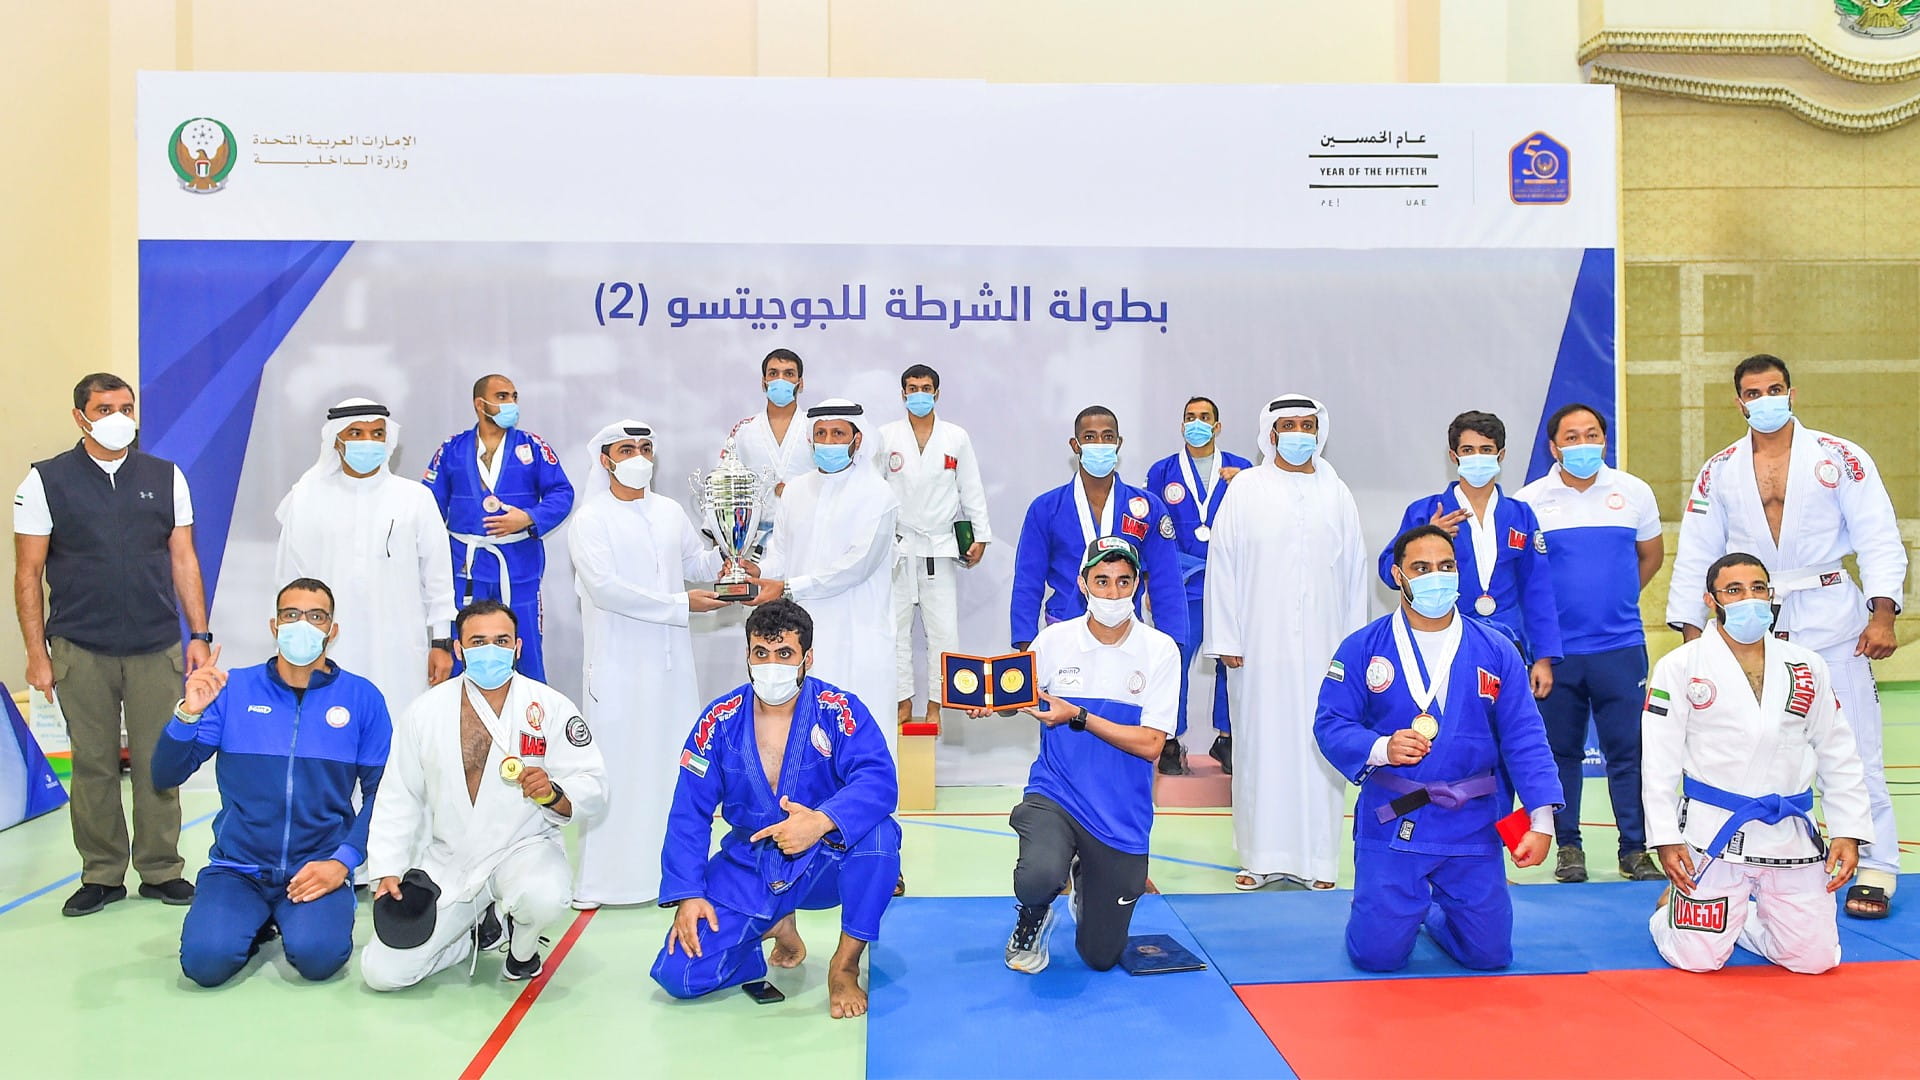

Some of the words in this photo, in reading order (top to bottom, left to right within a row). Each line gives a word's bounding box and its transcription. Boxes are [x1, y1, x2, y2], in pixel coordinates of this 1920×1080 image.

[252, 134, 302, 147] المتحدة
[306, 134, 359, 149] العربية
[1320, 130, 1392, 148] الخمسين
[1396, 131, 1426, 148] عام
[253, 154, 373, 169] الداخلية
[376, 155, 408, 169] وزارة
[1320, 167, 1345, 176] YEAR
[1348, 167, 1361, 176] OF
[1365, 167, 1382, 176] THE
[1385, 167, 1427, 176] FIFTIETH
[594, 282, 649, 326] (2)
[667, 284, 866, 331] للجوجيتسو
[885, 282, 1031, 330] الشرطة
[1048, 286, 1168, 334] بطولة
[1675, 895, 1725, 930] UAEJJ
